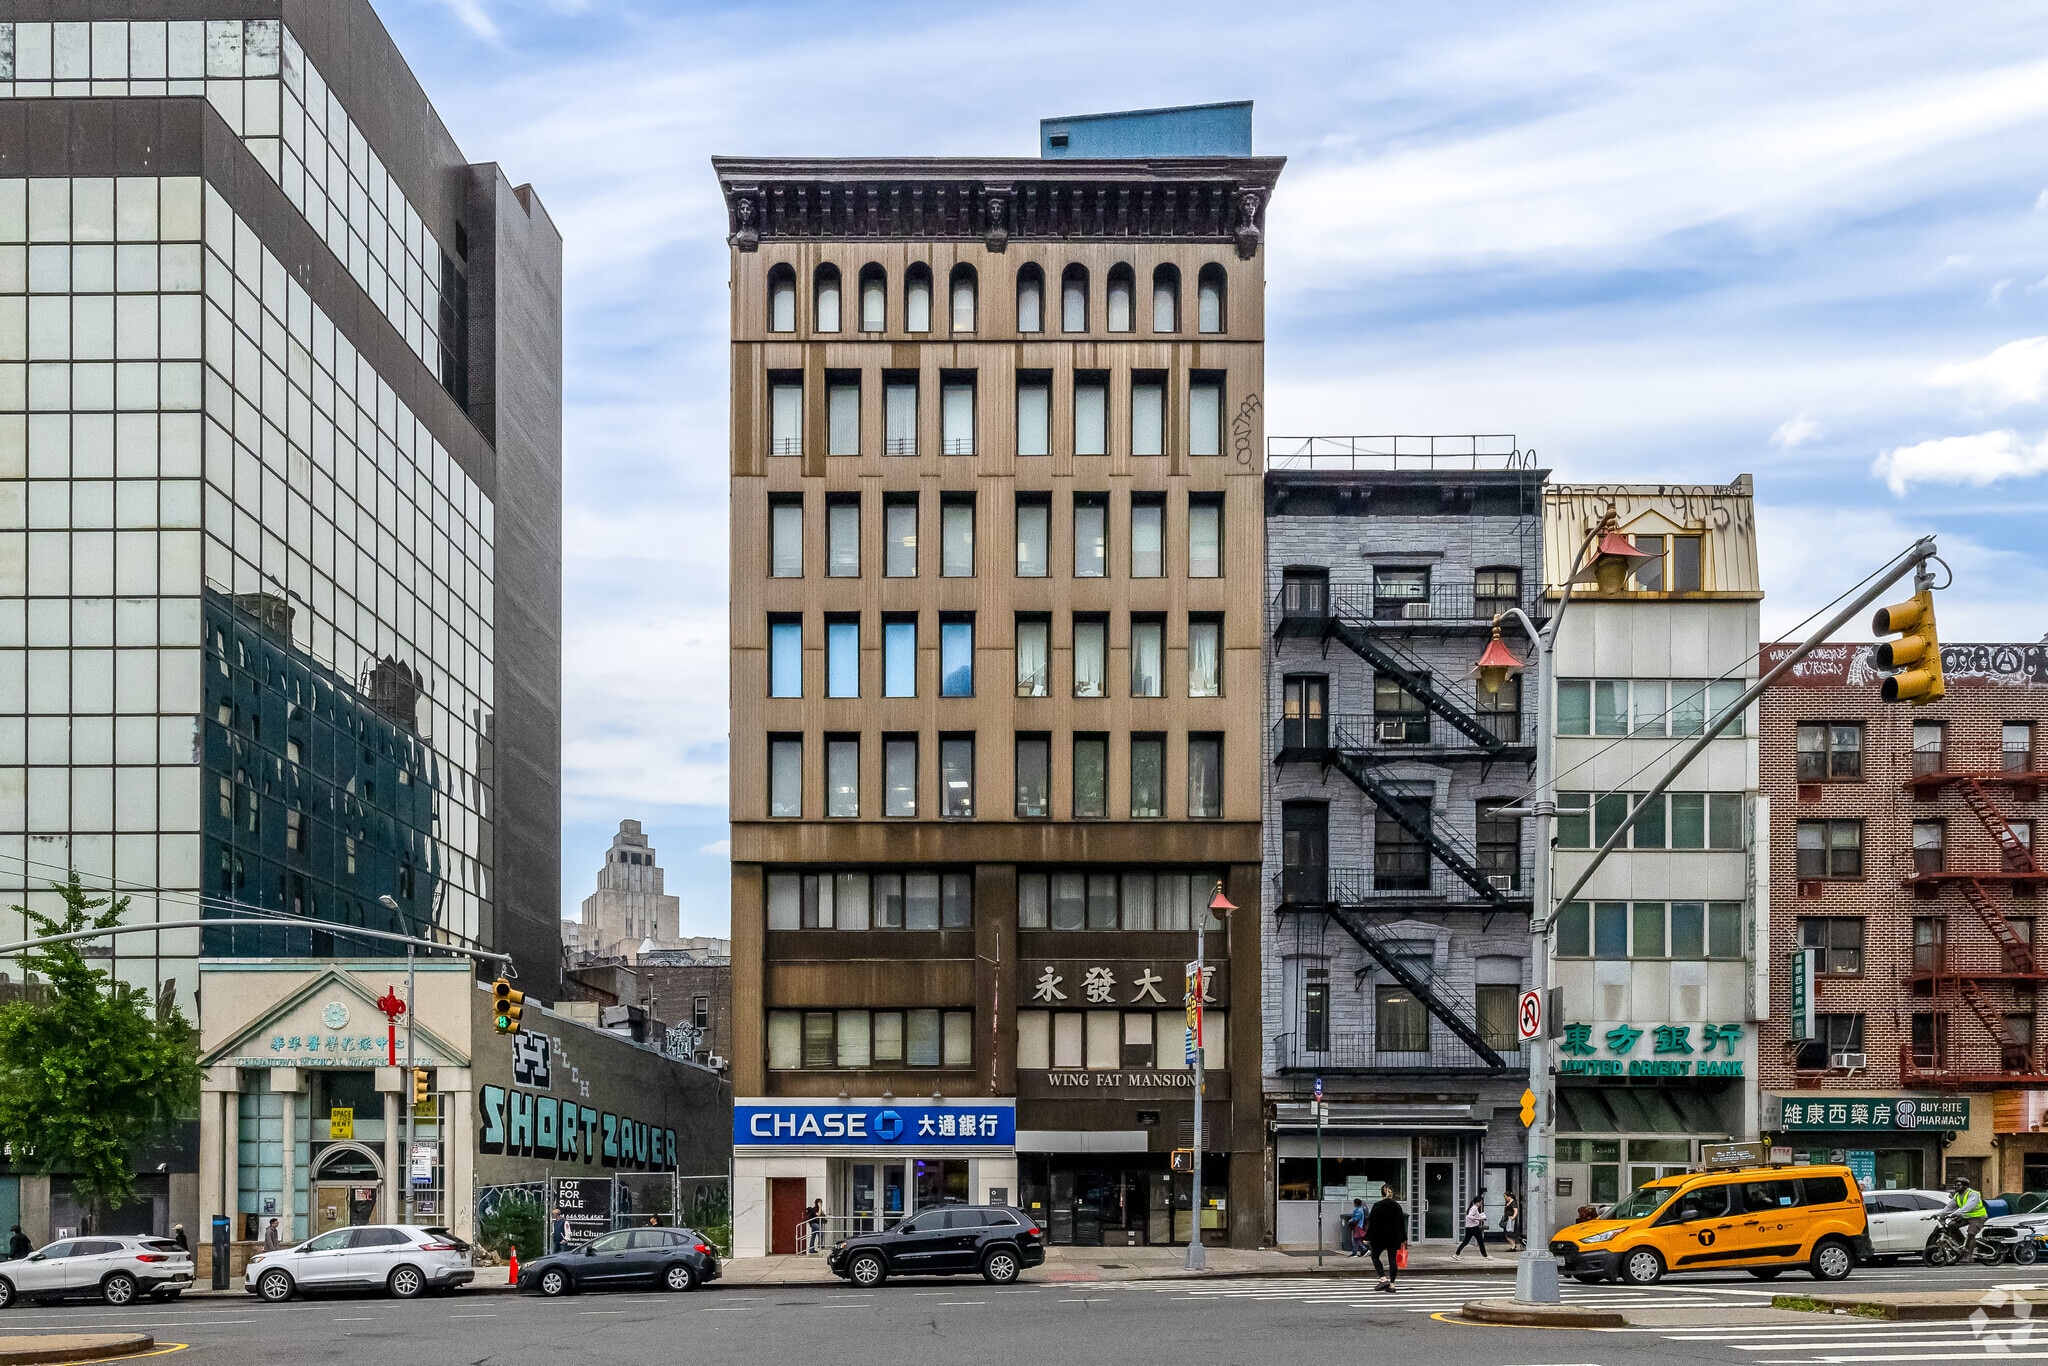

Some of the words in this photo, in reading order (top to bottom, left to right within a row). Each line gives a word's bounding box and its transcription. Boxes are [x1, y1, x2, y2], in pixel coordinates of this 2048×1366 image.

[1560, 1023, 1745, 1056] 東方銀行
[1561, 1060, 1624, 1075] UNITED
[1629, 1060, 1693, 1075] ORIENT
[1697, 1060, 1745, 1076] BANK
[1048, 1073, 1089, 1087] WING
[1096, 1073, 1123, 1087] FAT
[1128, 1073, 1196, 1088] MANSION
[1784, 1103, 1892, 1125] 維康西藥房
[1920, 1102, 1963, 1113] BUY-RITE
[750, 1113, 868, 1137] CHASE
[918, 1114, 999, 1137] 大通銀行
[1916, 1115, 1967, 1126] PHARMACY
[479, 1084, 598, 1164] SHORT
[601, 1111, 678, 1173] ZAVER
[560, 1181, 579, 1190] LOT
[560, 1190, 580, 1199] FOR
[559, 1199, 584, 1208] SALE
